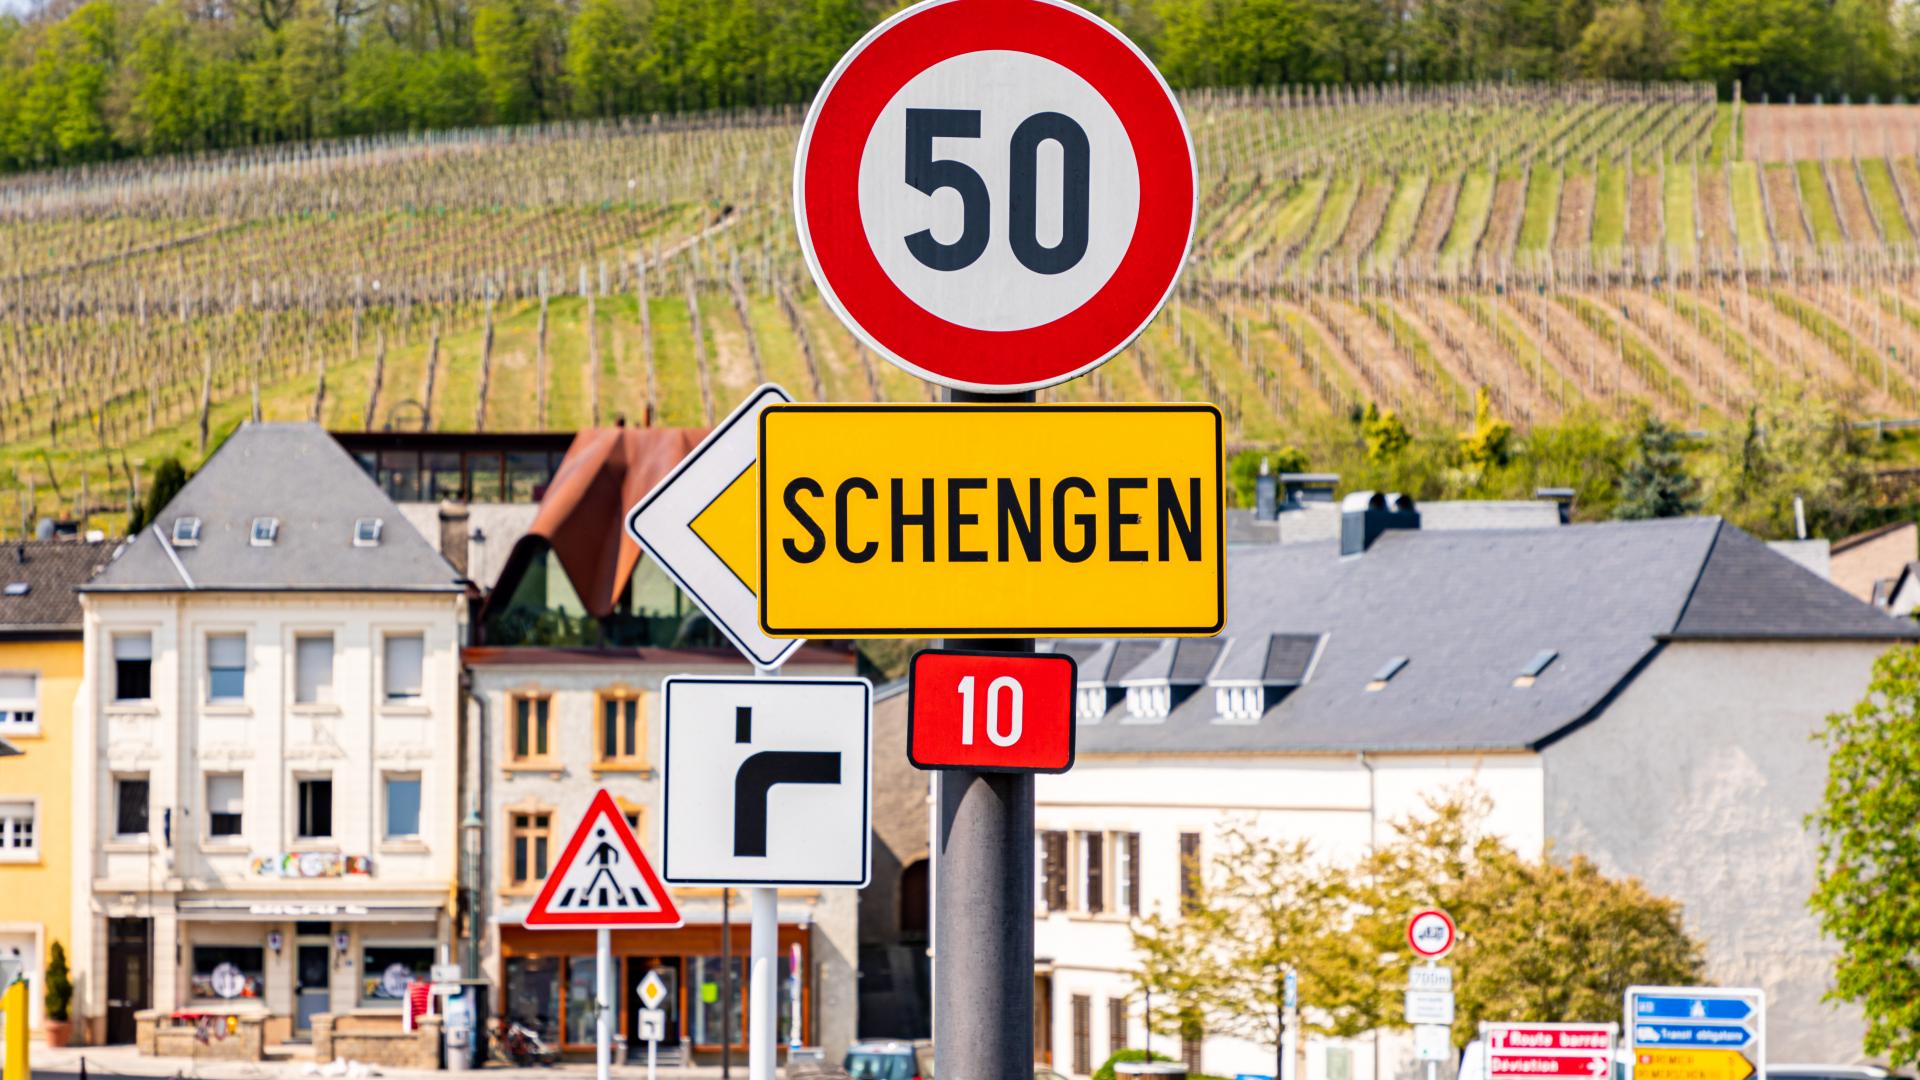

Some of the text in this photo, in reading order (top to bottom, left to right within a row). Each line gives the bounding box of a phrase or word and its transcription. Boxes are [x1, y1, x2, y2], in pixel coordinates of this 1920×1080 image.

[904, 108, 1090, 275] 50
[783, 477, 1202, 563] SCHENGEN
[957, 676, 1024, 747] 10
[1509, 1030, 1553, 1047] Route
[1661, 1028, 1743, 1043] Transit obligatoire
